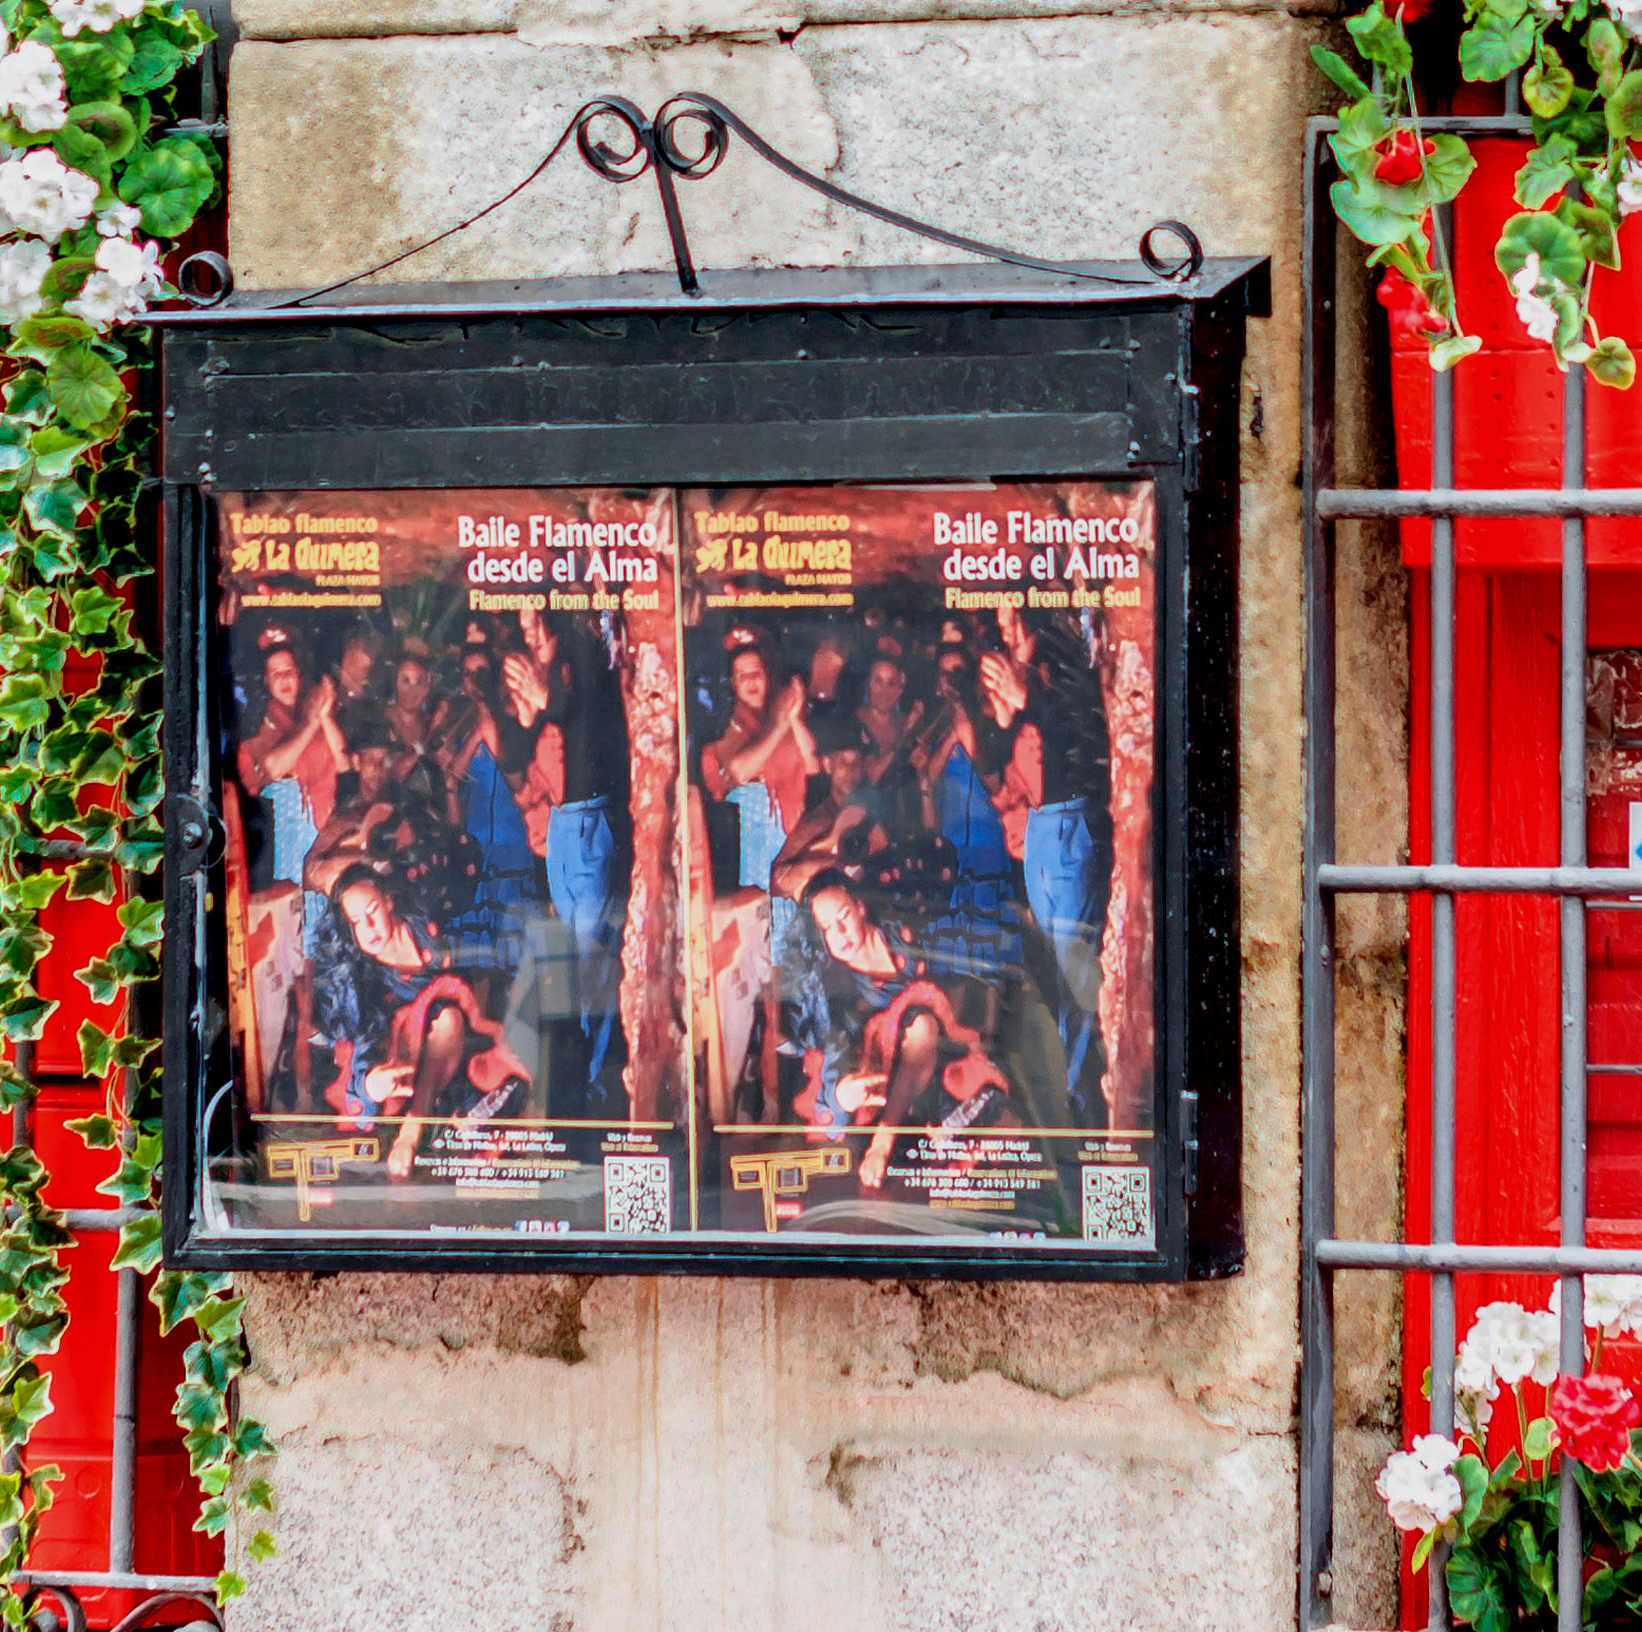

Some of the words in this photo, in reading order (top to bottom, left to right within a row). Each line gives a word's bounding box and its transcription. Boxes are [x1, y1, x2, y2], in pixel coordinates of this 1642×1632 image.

[230, 512, 291, 534] Tablao
[295, 512, 379, 534] flamenco
[457, 515, 520, 548] Baile
[528, 515, 657, 548] Flamenco
[694, 511, 759, 534] Tablao
[764, 511, 851, 533] flamenco
[933, 512, 998, 545] Baile
[1007, 511, 1139, 544] Flamenco
[265, 539, 291, 571] La
[467, 551, 544, 583] desde
[552, 550, 576, 583] el
[584, 550, 658, 583] Alma
[732, 538, 759, 571] La
[943, 547, 1022, 580] desde
[1030, 546, 1055, 580] el
[1063, 546, 1140, 579] Alma
[469, 589, 547, 610] Flamenco
[550, 588, 589, 610] from
[592, 589, 620, 610] the
[623, 588, 660, 610] Soul
[945, 586, 1025, 609] Flamenco
[1027, 585, 1070, 609] from
[1072, 587, 1101, 608] the
[1104, 585, 1141, 608] Soul
